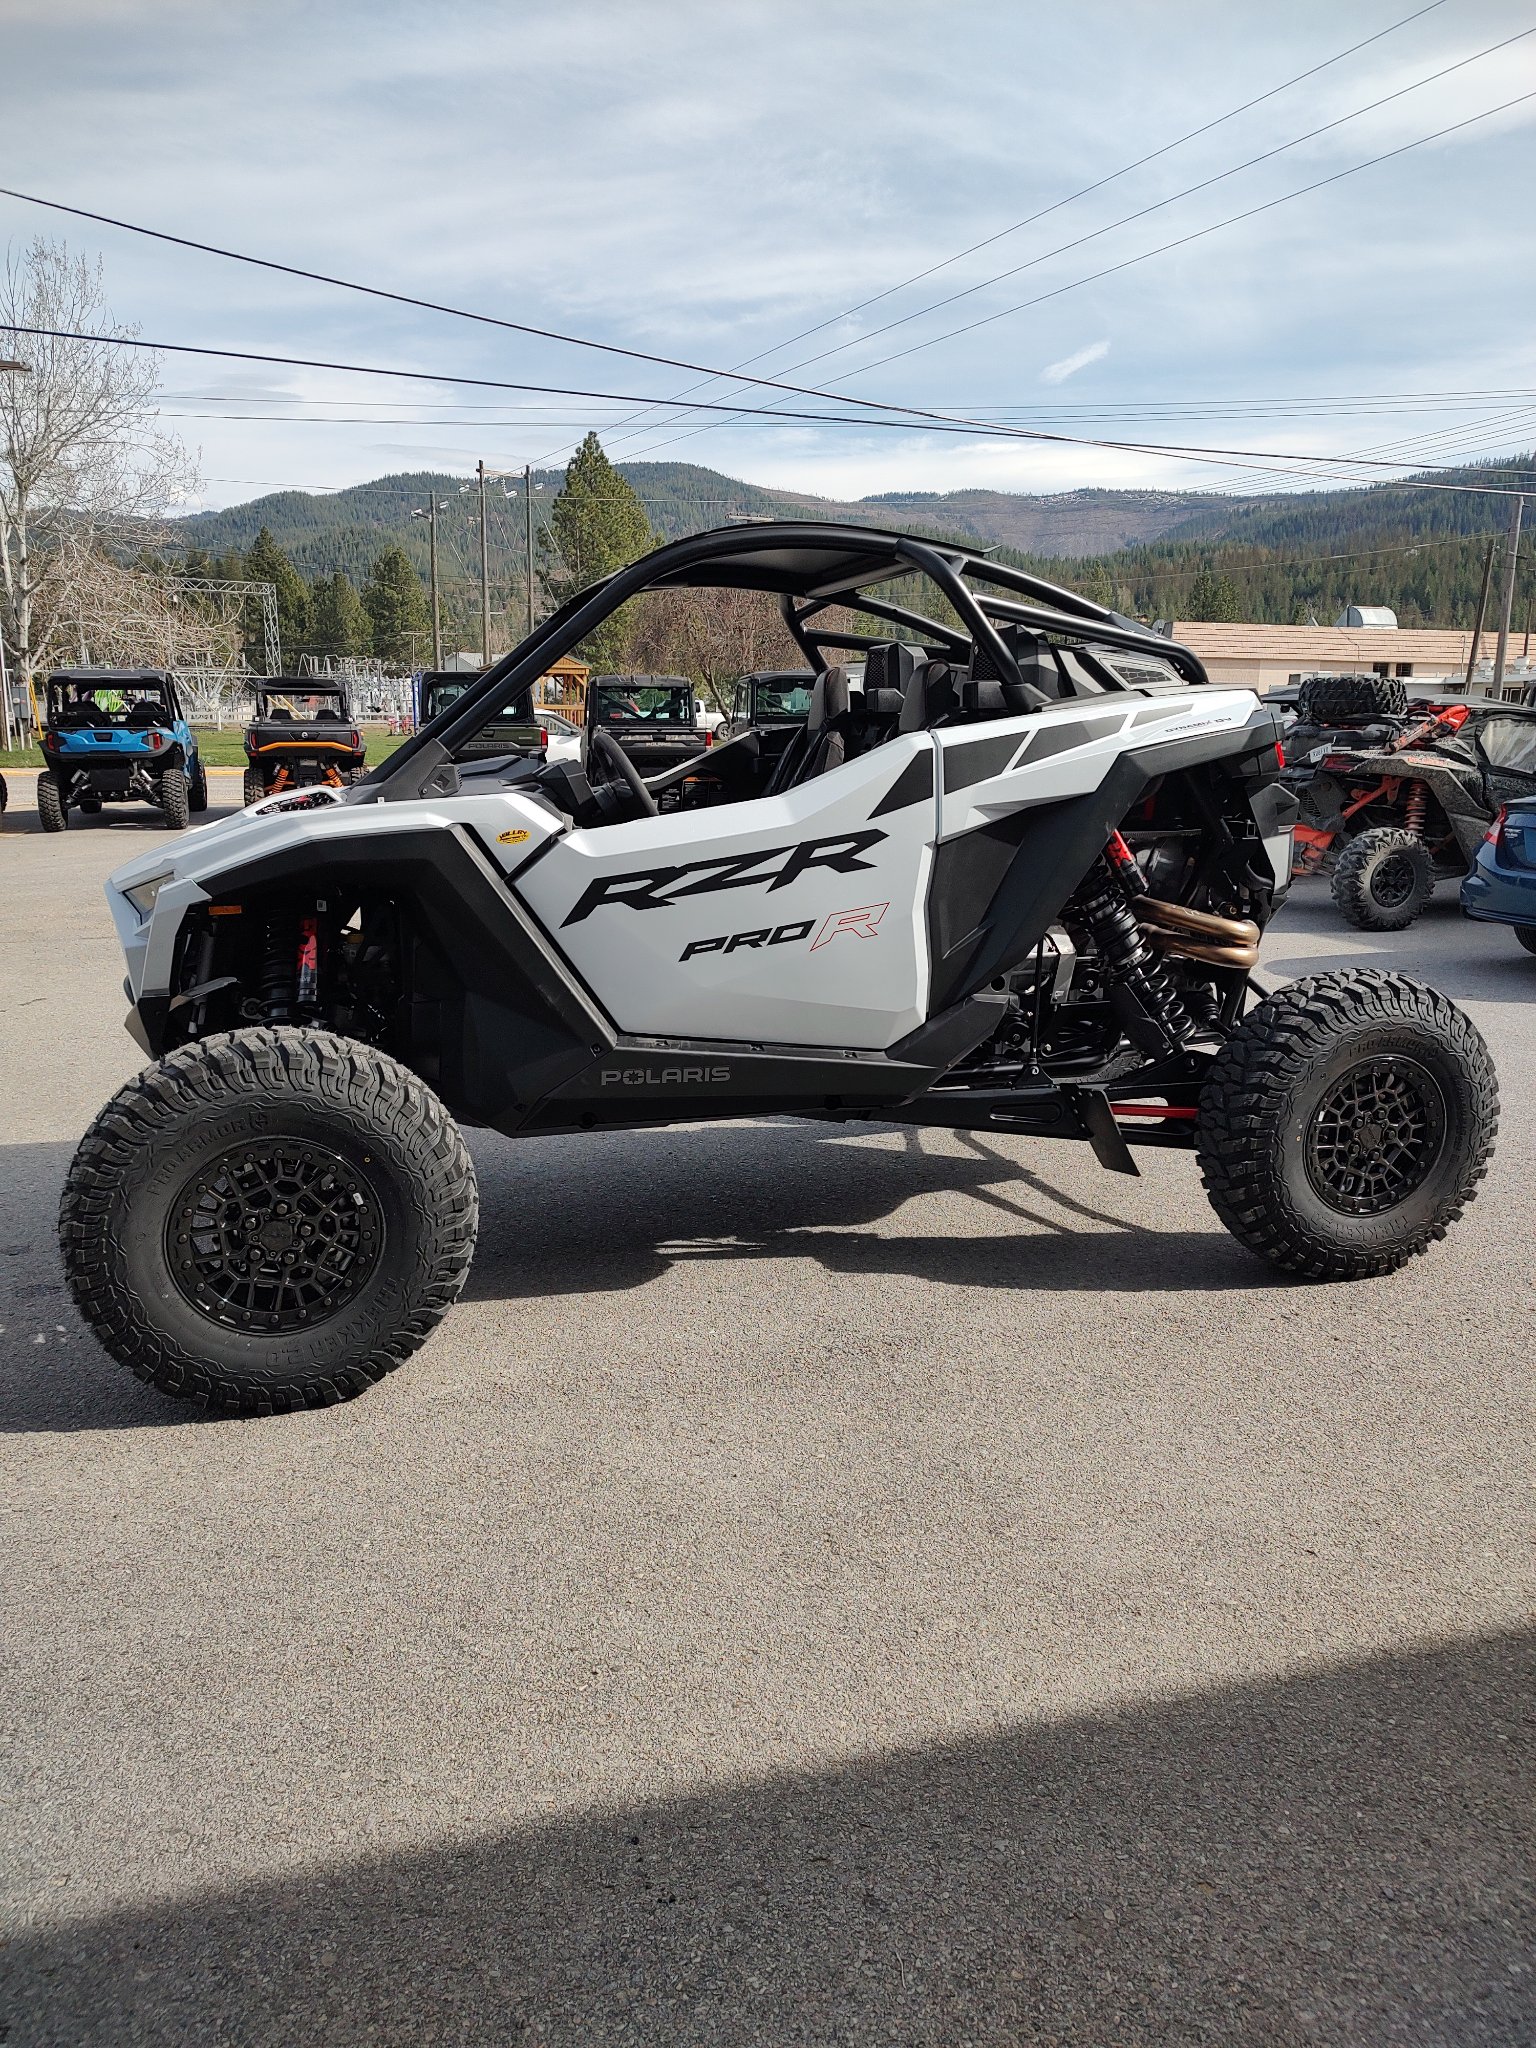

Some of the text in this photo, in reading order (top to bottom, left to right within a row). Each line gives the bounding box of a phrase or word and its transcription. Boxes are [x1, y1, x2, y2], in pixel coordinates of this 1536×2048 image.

[559, 828, 890, 929] RZR
[678, 902, 891, 962] PRO R
[601, 1066, 731, 1086] POLARIS
